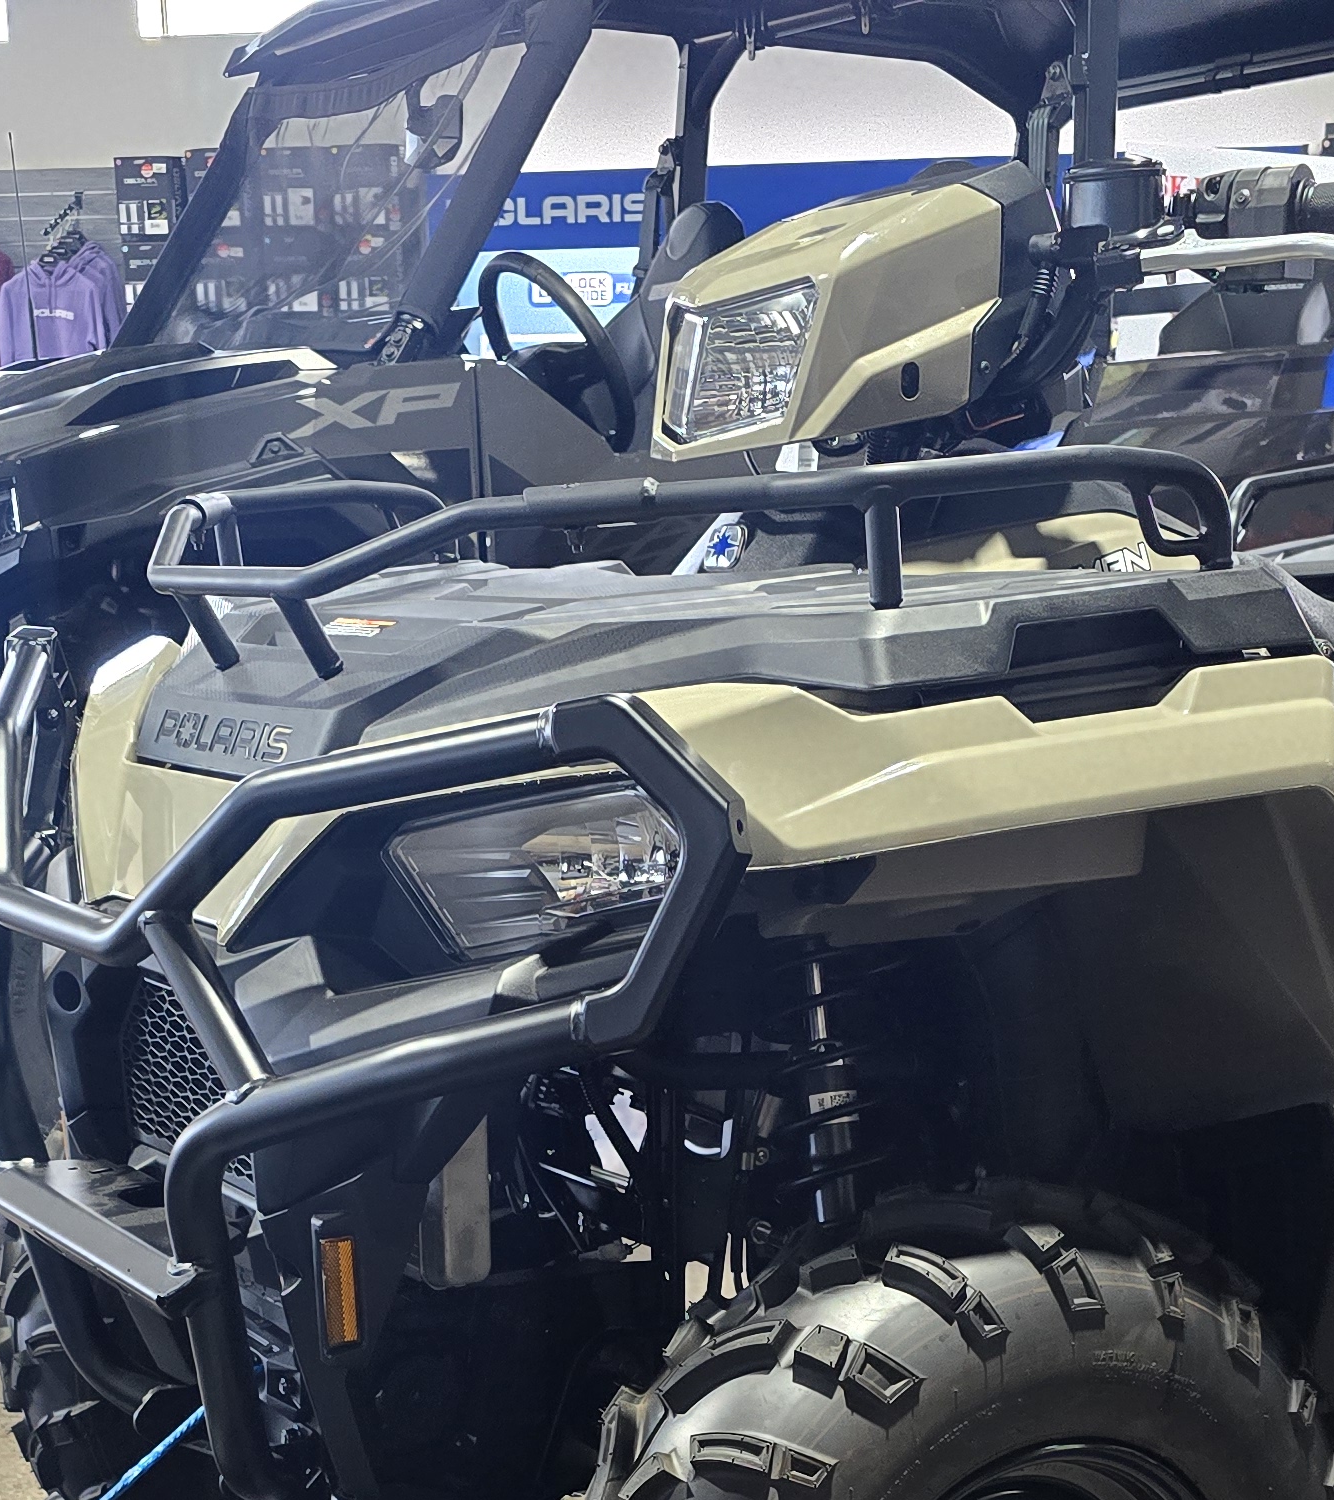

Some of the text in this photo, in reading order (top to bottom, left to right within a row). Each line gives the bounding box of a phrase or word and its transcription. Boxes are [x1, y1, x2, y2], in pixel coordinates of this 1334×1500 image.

[494, 193, 644, 226] OLARIS
[286, 382, 462, 439] XP
[154, 709, 294, 763] POLARIS
